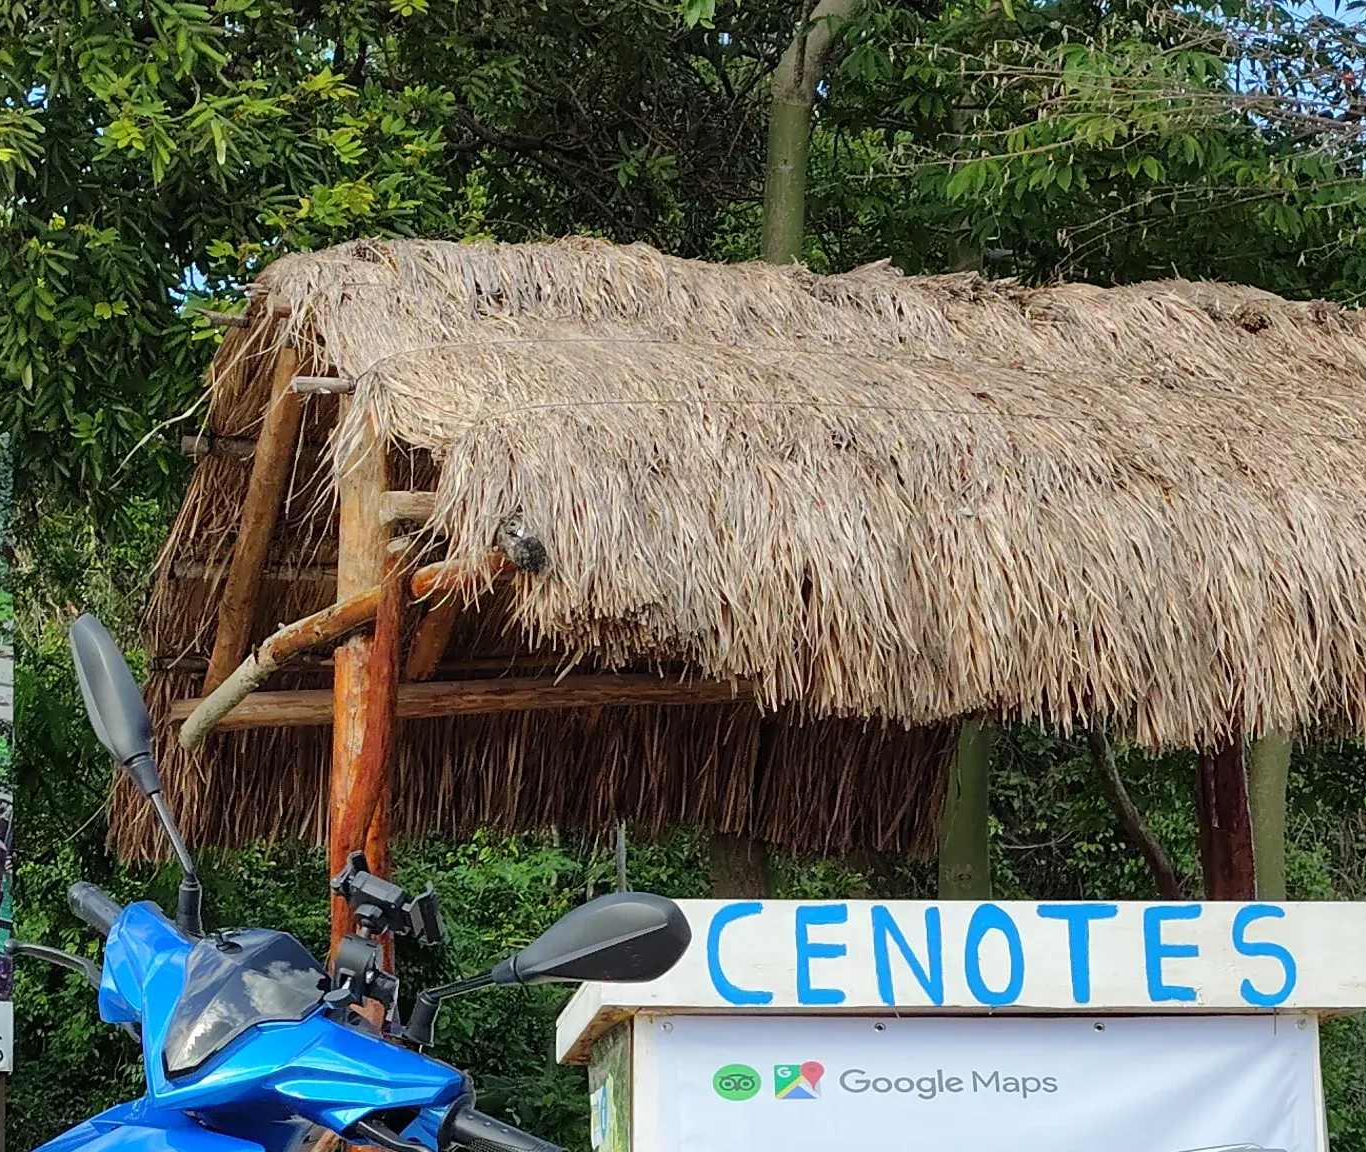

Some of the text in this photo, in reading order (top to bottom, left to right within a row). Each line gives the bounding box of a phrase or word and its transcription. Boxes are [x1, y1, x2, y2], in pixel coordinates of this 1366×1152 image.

[707, 902, 1297, 1006] CENOTES
[839, 1068, 1059, 1100] Google Maps
